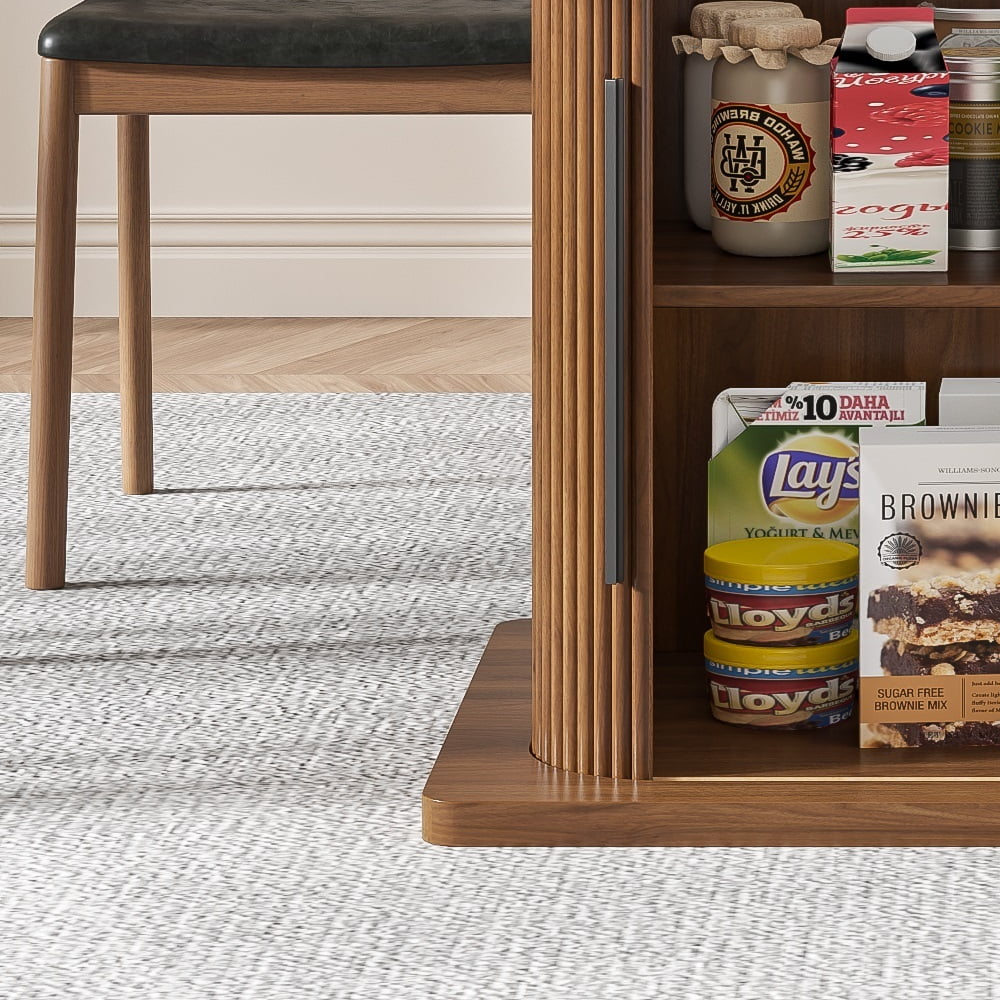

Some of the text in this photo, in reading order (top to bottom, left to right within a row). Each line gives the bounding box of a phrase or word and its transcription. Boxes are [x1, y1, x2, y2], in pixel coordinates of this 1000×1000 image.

[949, 122, 993, 135] COOKIE
[785, 394, 838, 421] %10
[839, 395, 890, 409] DAHA
[757, 410, 905, 422] ETİMİZ AVANTAJLI
[812, 527, 824, 539] &
[829, 627, 851, 641] Be
[877, 687, 944, 698] SUGAR FREE
[874, 700, 948, 711] BROWNIE MIX
